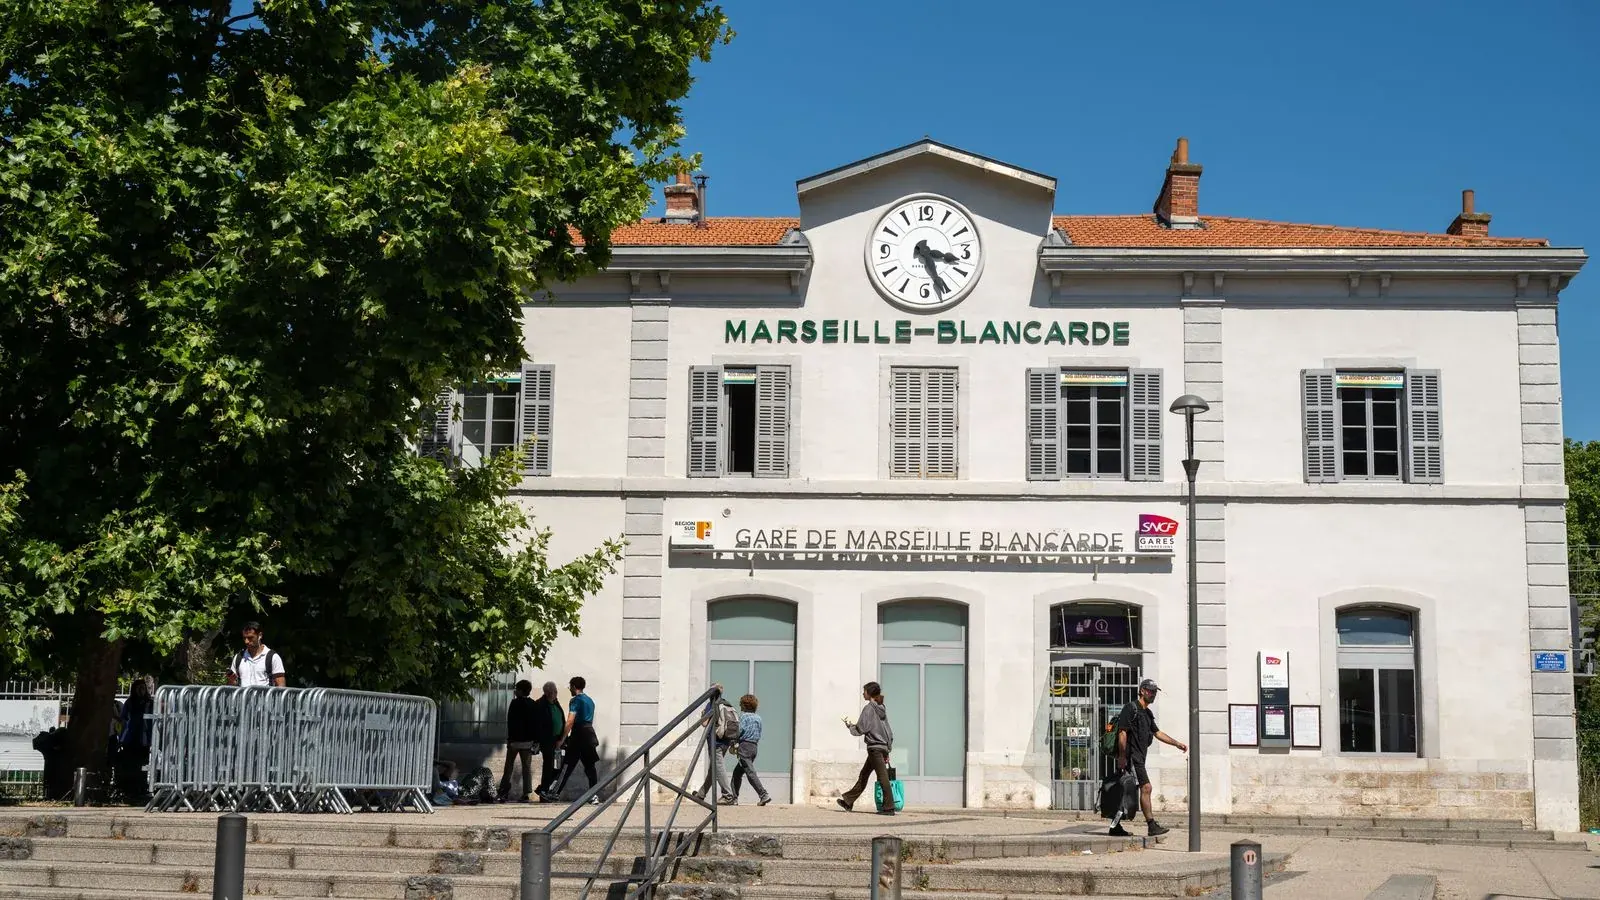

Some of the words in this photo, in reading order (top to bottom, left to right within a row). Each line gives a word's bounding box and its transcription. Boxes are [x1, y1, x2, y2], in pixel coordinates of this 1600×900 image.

[918, 205, 934, 221] 12
[880, 243, 891, 259] 9
[960, 243, 971, 259] 3
[919, 283, 930, 298] 6
[1141, 522, 1176, 532] SNCF
[735, 528, 798, 548] GARE
[805, 529, 837, 548] DE
[847, 530, 971, 549] MARSEILLE
[981, 531, 1124, 551] BLANCARDE
